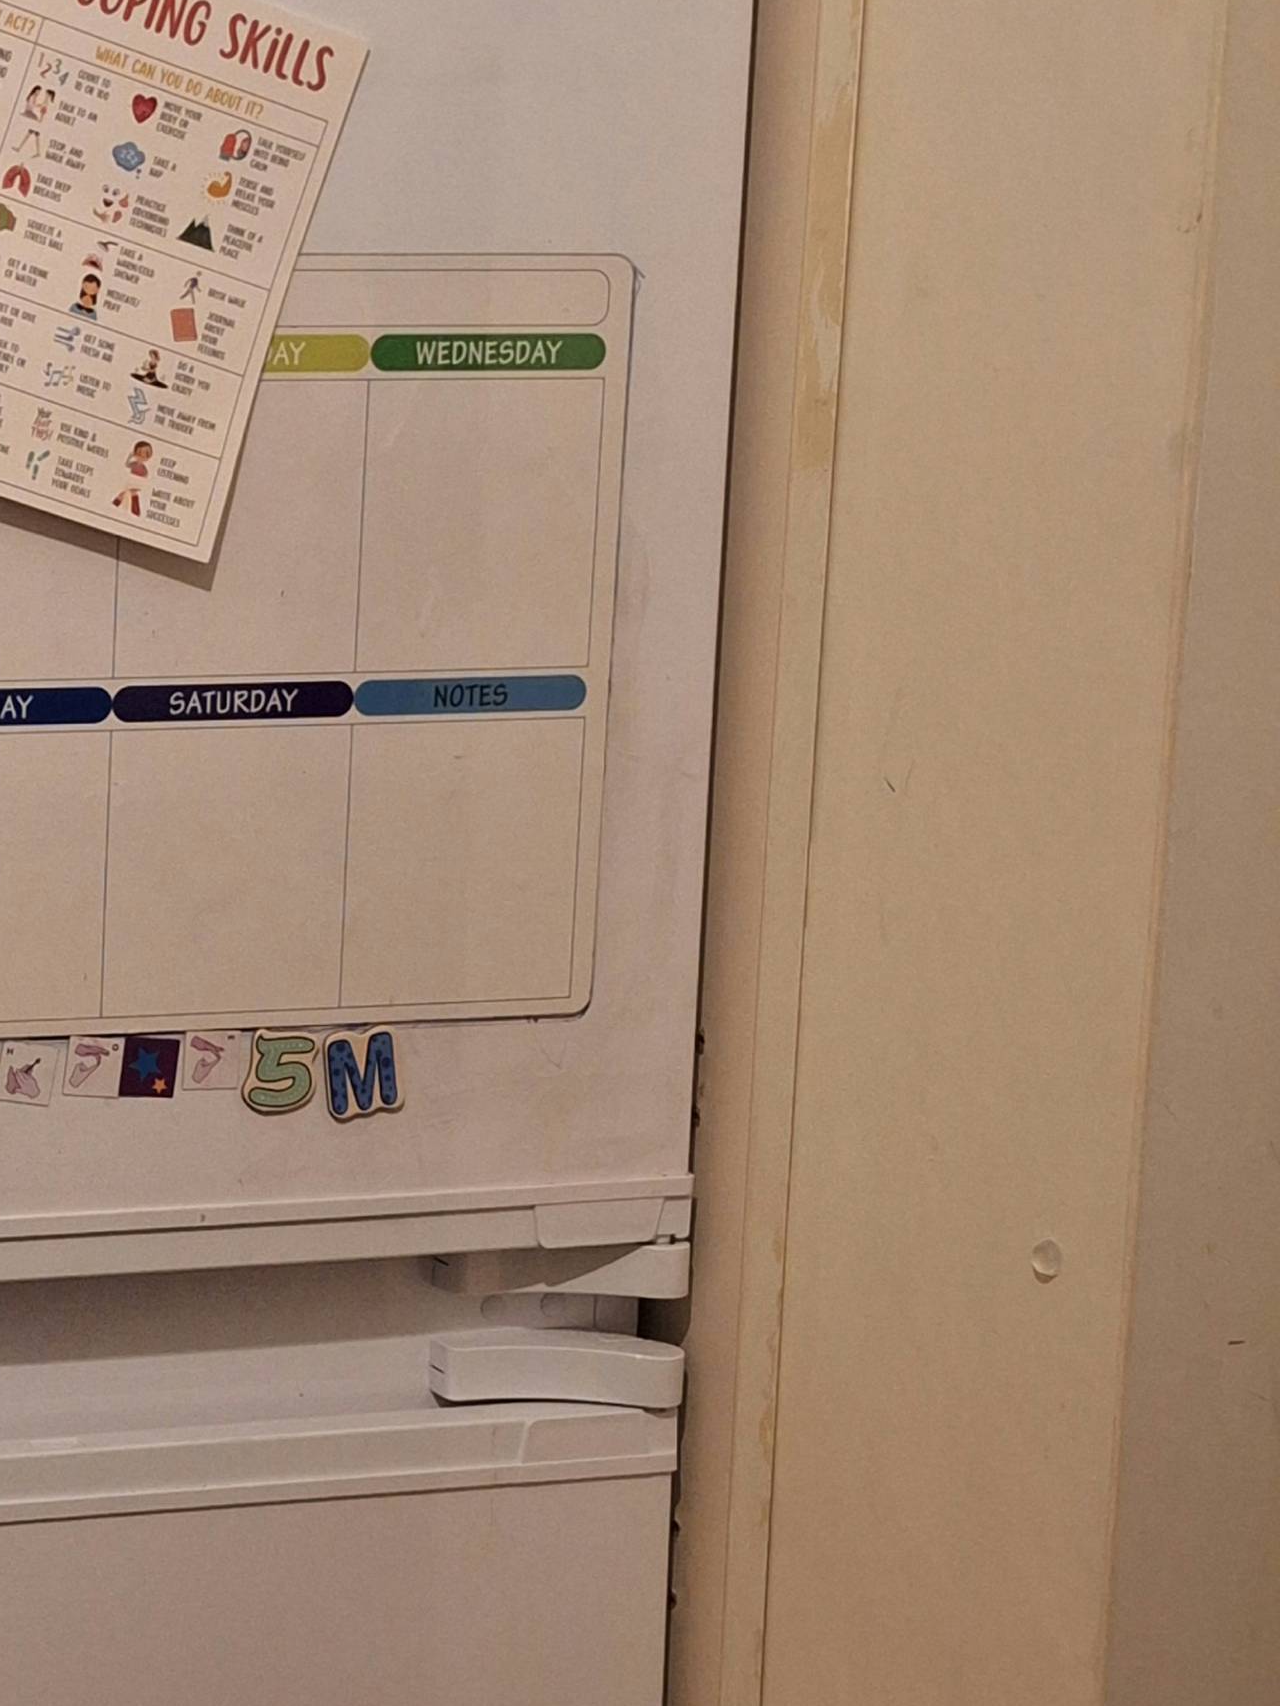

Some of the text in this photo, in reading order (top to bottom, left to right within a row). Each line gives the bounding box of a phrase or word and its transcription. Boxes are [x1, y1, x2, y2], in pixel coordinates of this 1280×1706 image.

[3, 10, 36, 35] ACT?
[94, 45, 264, 119] WHAT CAN YOU DO ABOUT IT?
[416, 340, 564, 366] WEDNESDAY
[168, 688, 298, 716] SATURDAY
[432, 683, 508, 709] NOTES
[246, 1031, 399, 1115] 5 M
